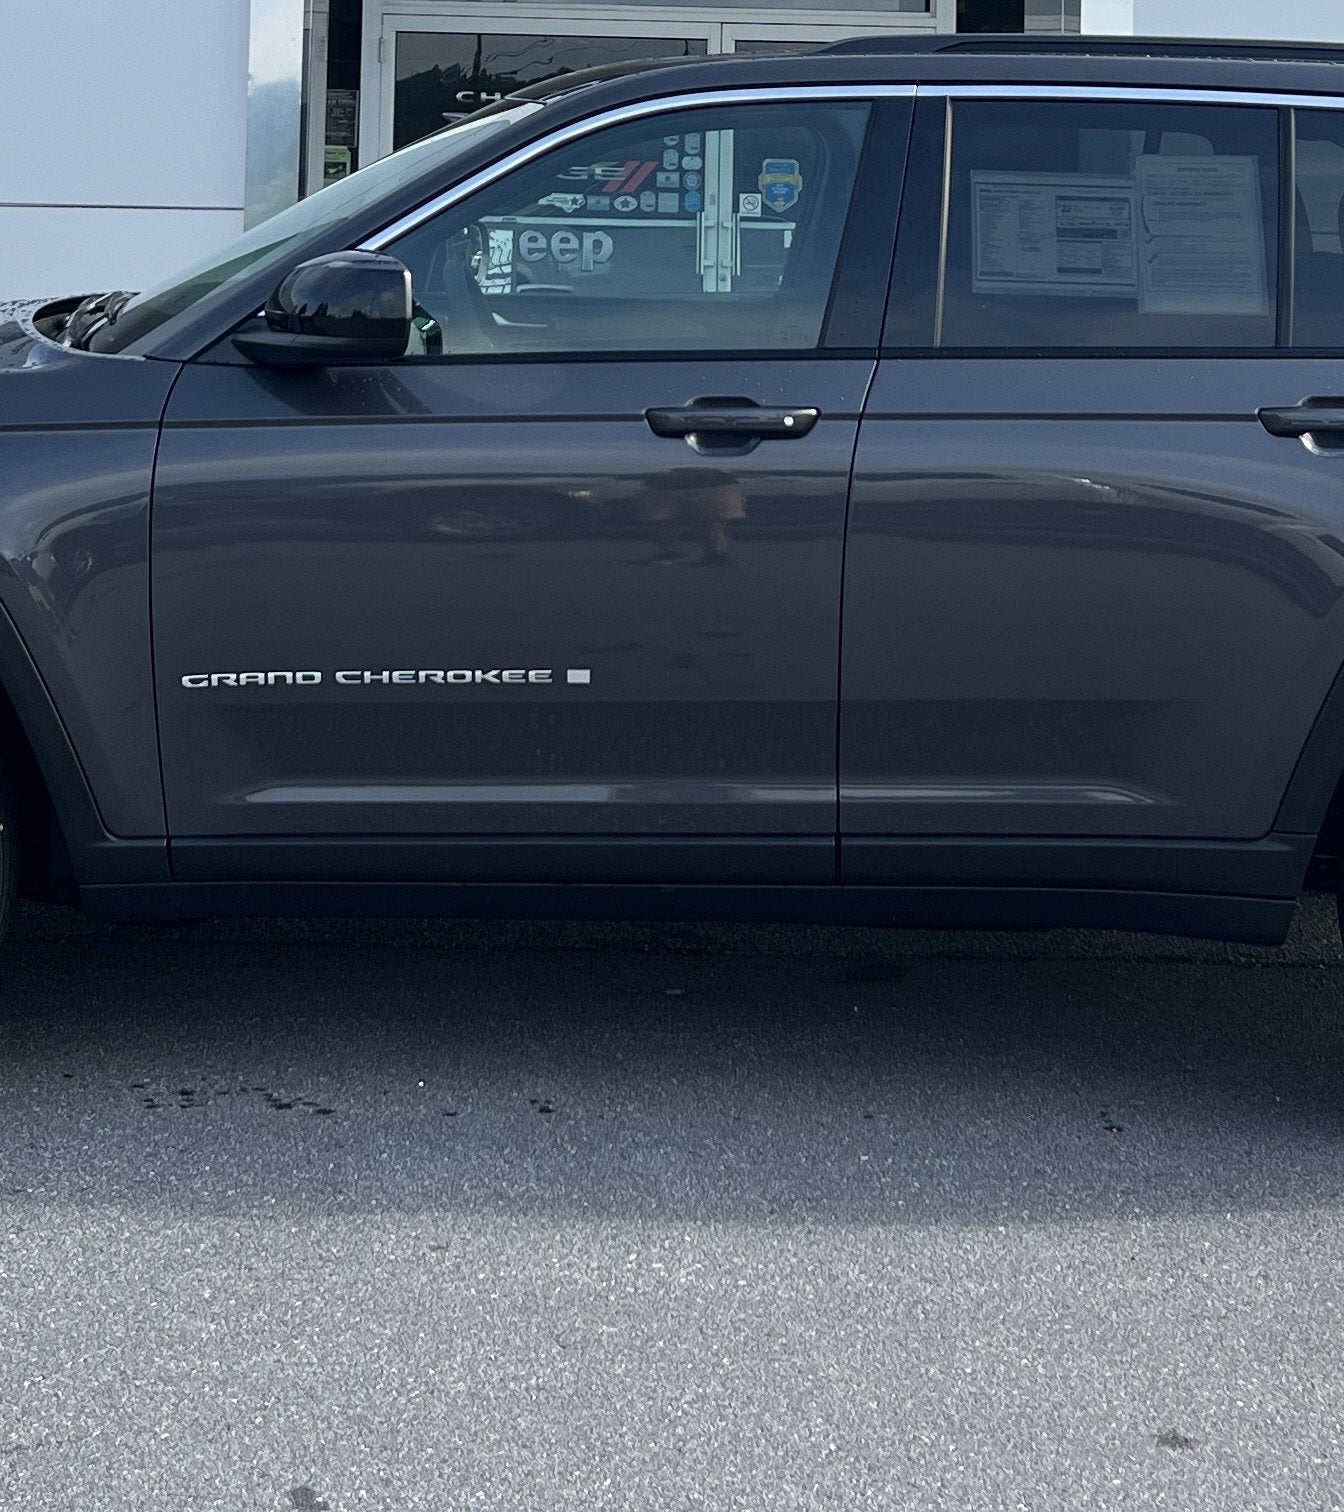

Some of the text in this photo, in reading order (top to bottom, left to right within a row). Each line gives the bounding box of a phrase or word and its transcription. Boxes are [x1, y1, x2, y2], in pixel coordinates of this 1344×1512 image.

[456, 91, 506, 103] CH
[518, 229, 614, 272] eep
[181, 668, 553, 688] GRAND CHEROKEE
